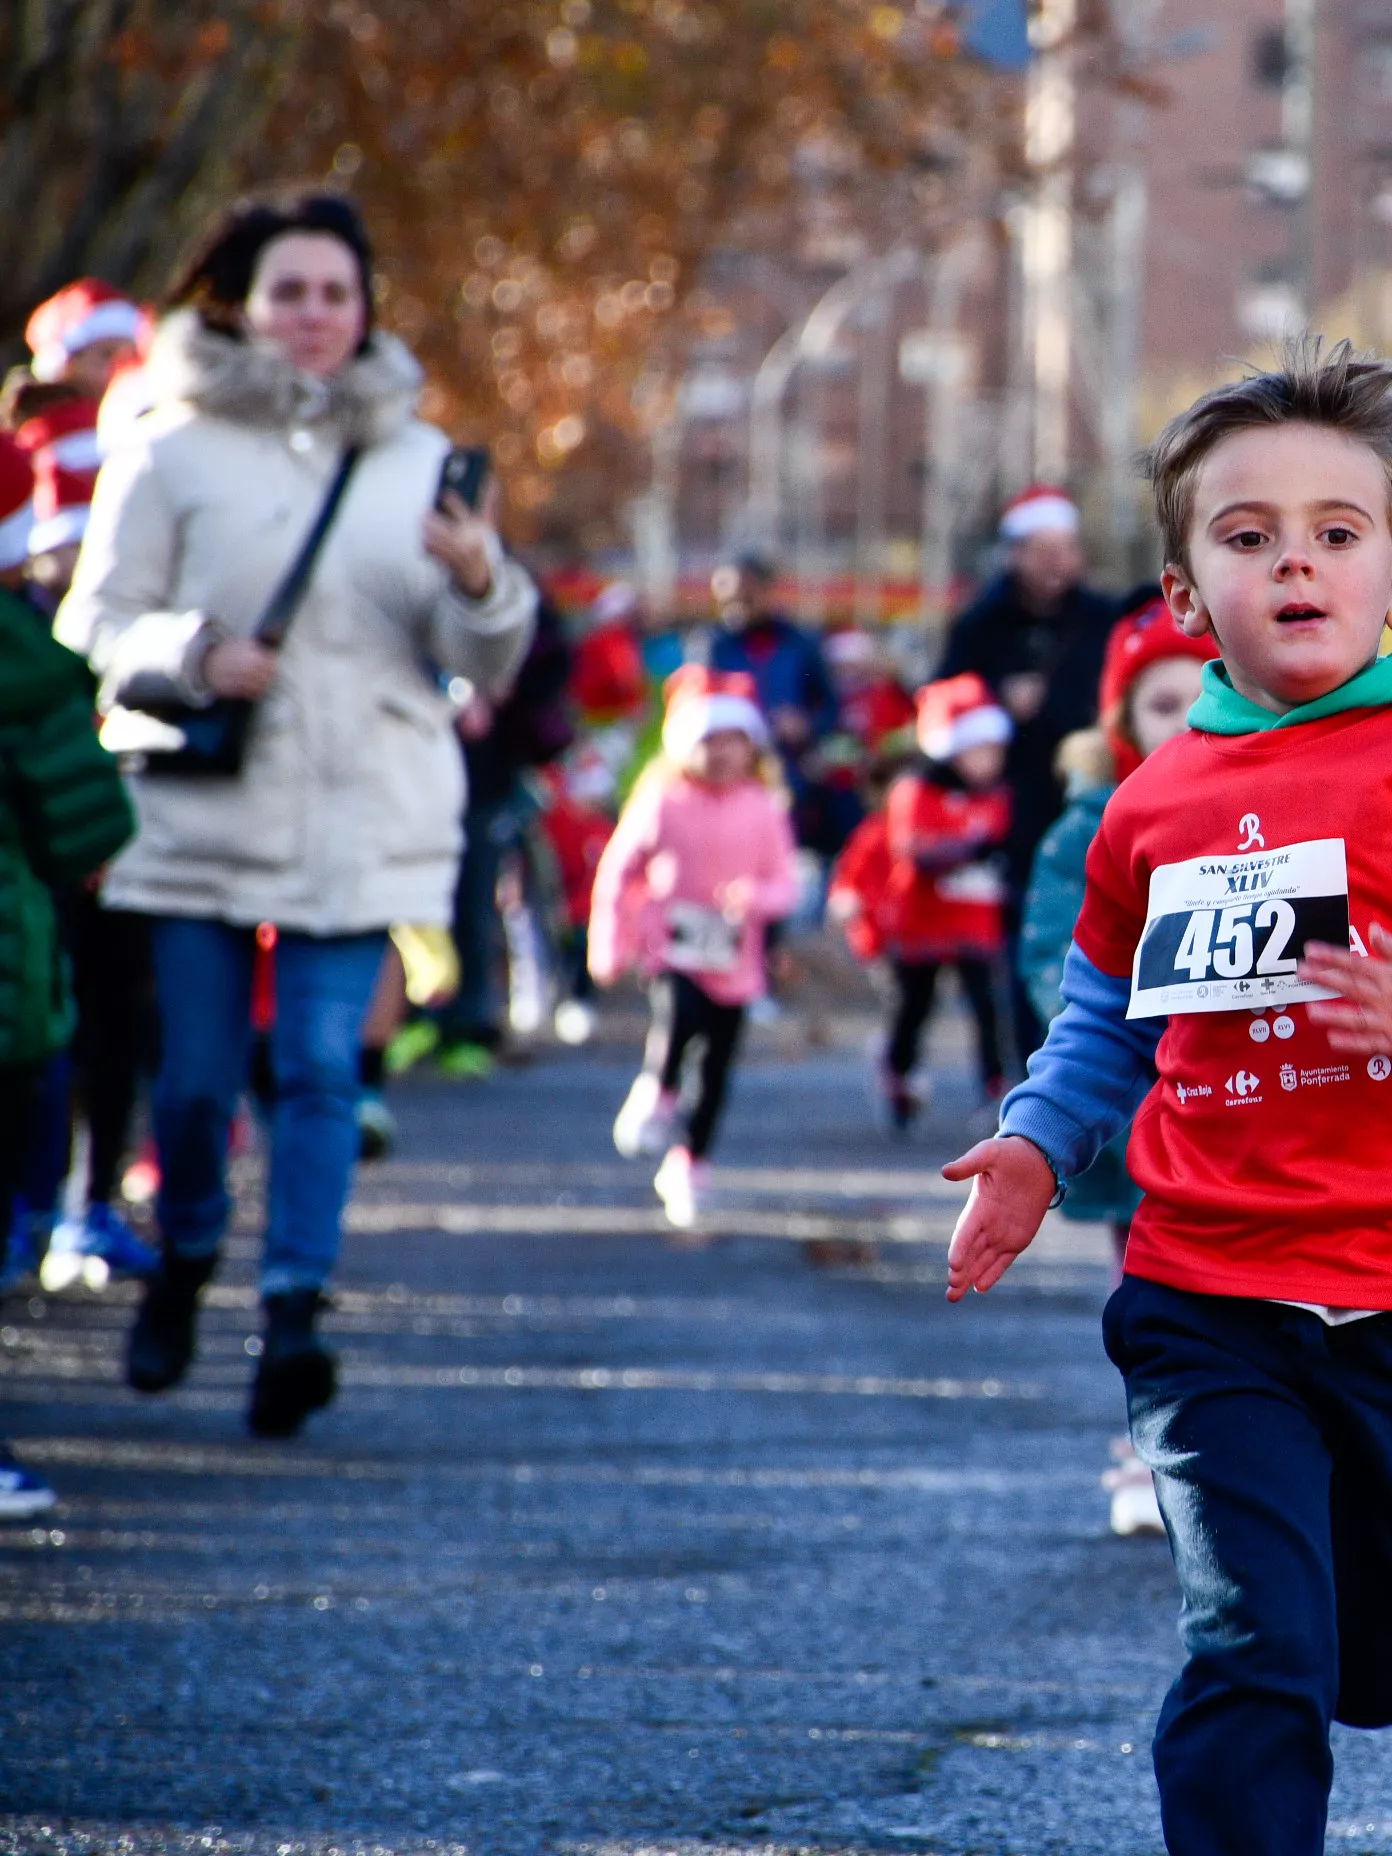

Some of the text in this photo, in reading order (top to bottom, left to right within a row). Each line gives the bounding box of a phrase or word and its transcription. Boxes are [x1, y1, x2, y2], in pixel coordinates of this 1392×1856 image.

[1199, 853, 1291, 875] SAN SILVESTRE
[1224, 870, 1274, 895] XLIV
[1173, 899, 1297, 981] 452
[1300, 1065, 1349, 1078] Ayuntamiento
[1300, 1073, 1350, 1087] Ponferrada
[1186, 1084, 1212, 1097] Cruz Roja
[1225, 1096, 1263, 1106] Carrefour
